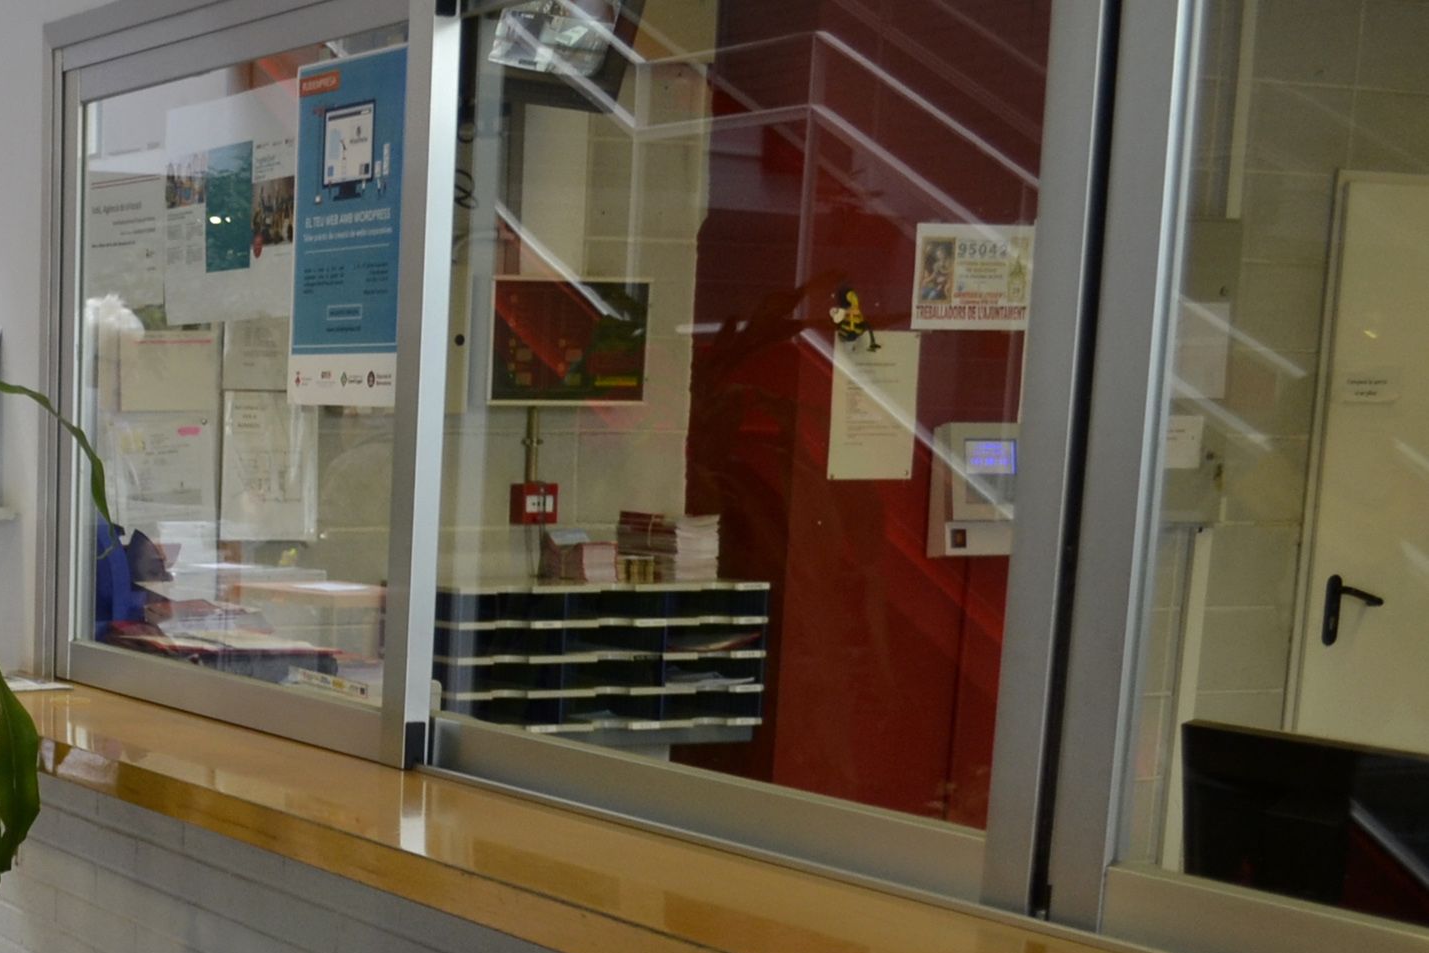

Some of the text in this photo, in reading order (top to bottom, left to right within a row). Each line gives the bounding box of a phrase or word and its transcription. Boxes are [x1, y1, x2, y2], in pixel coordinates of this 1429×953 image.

[957, 243, 1008, 258] 95042
[916, 305, 966, 320] TREBALLADORS
[967, 305, 976, 320] DE
